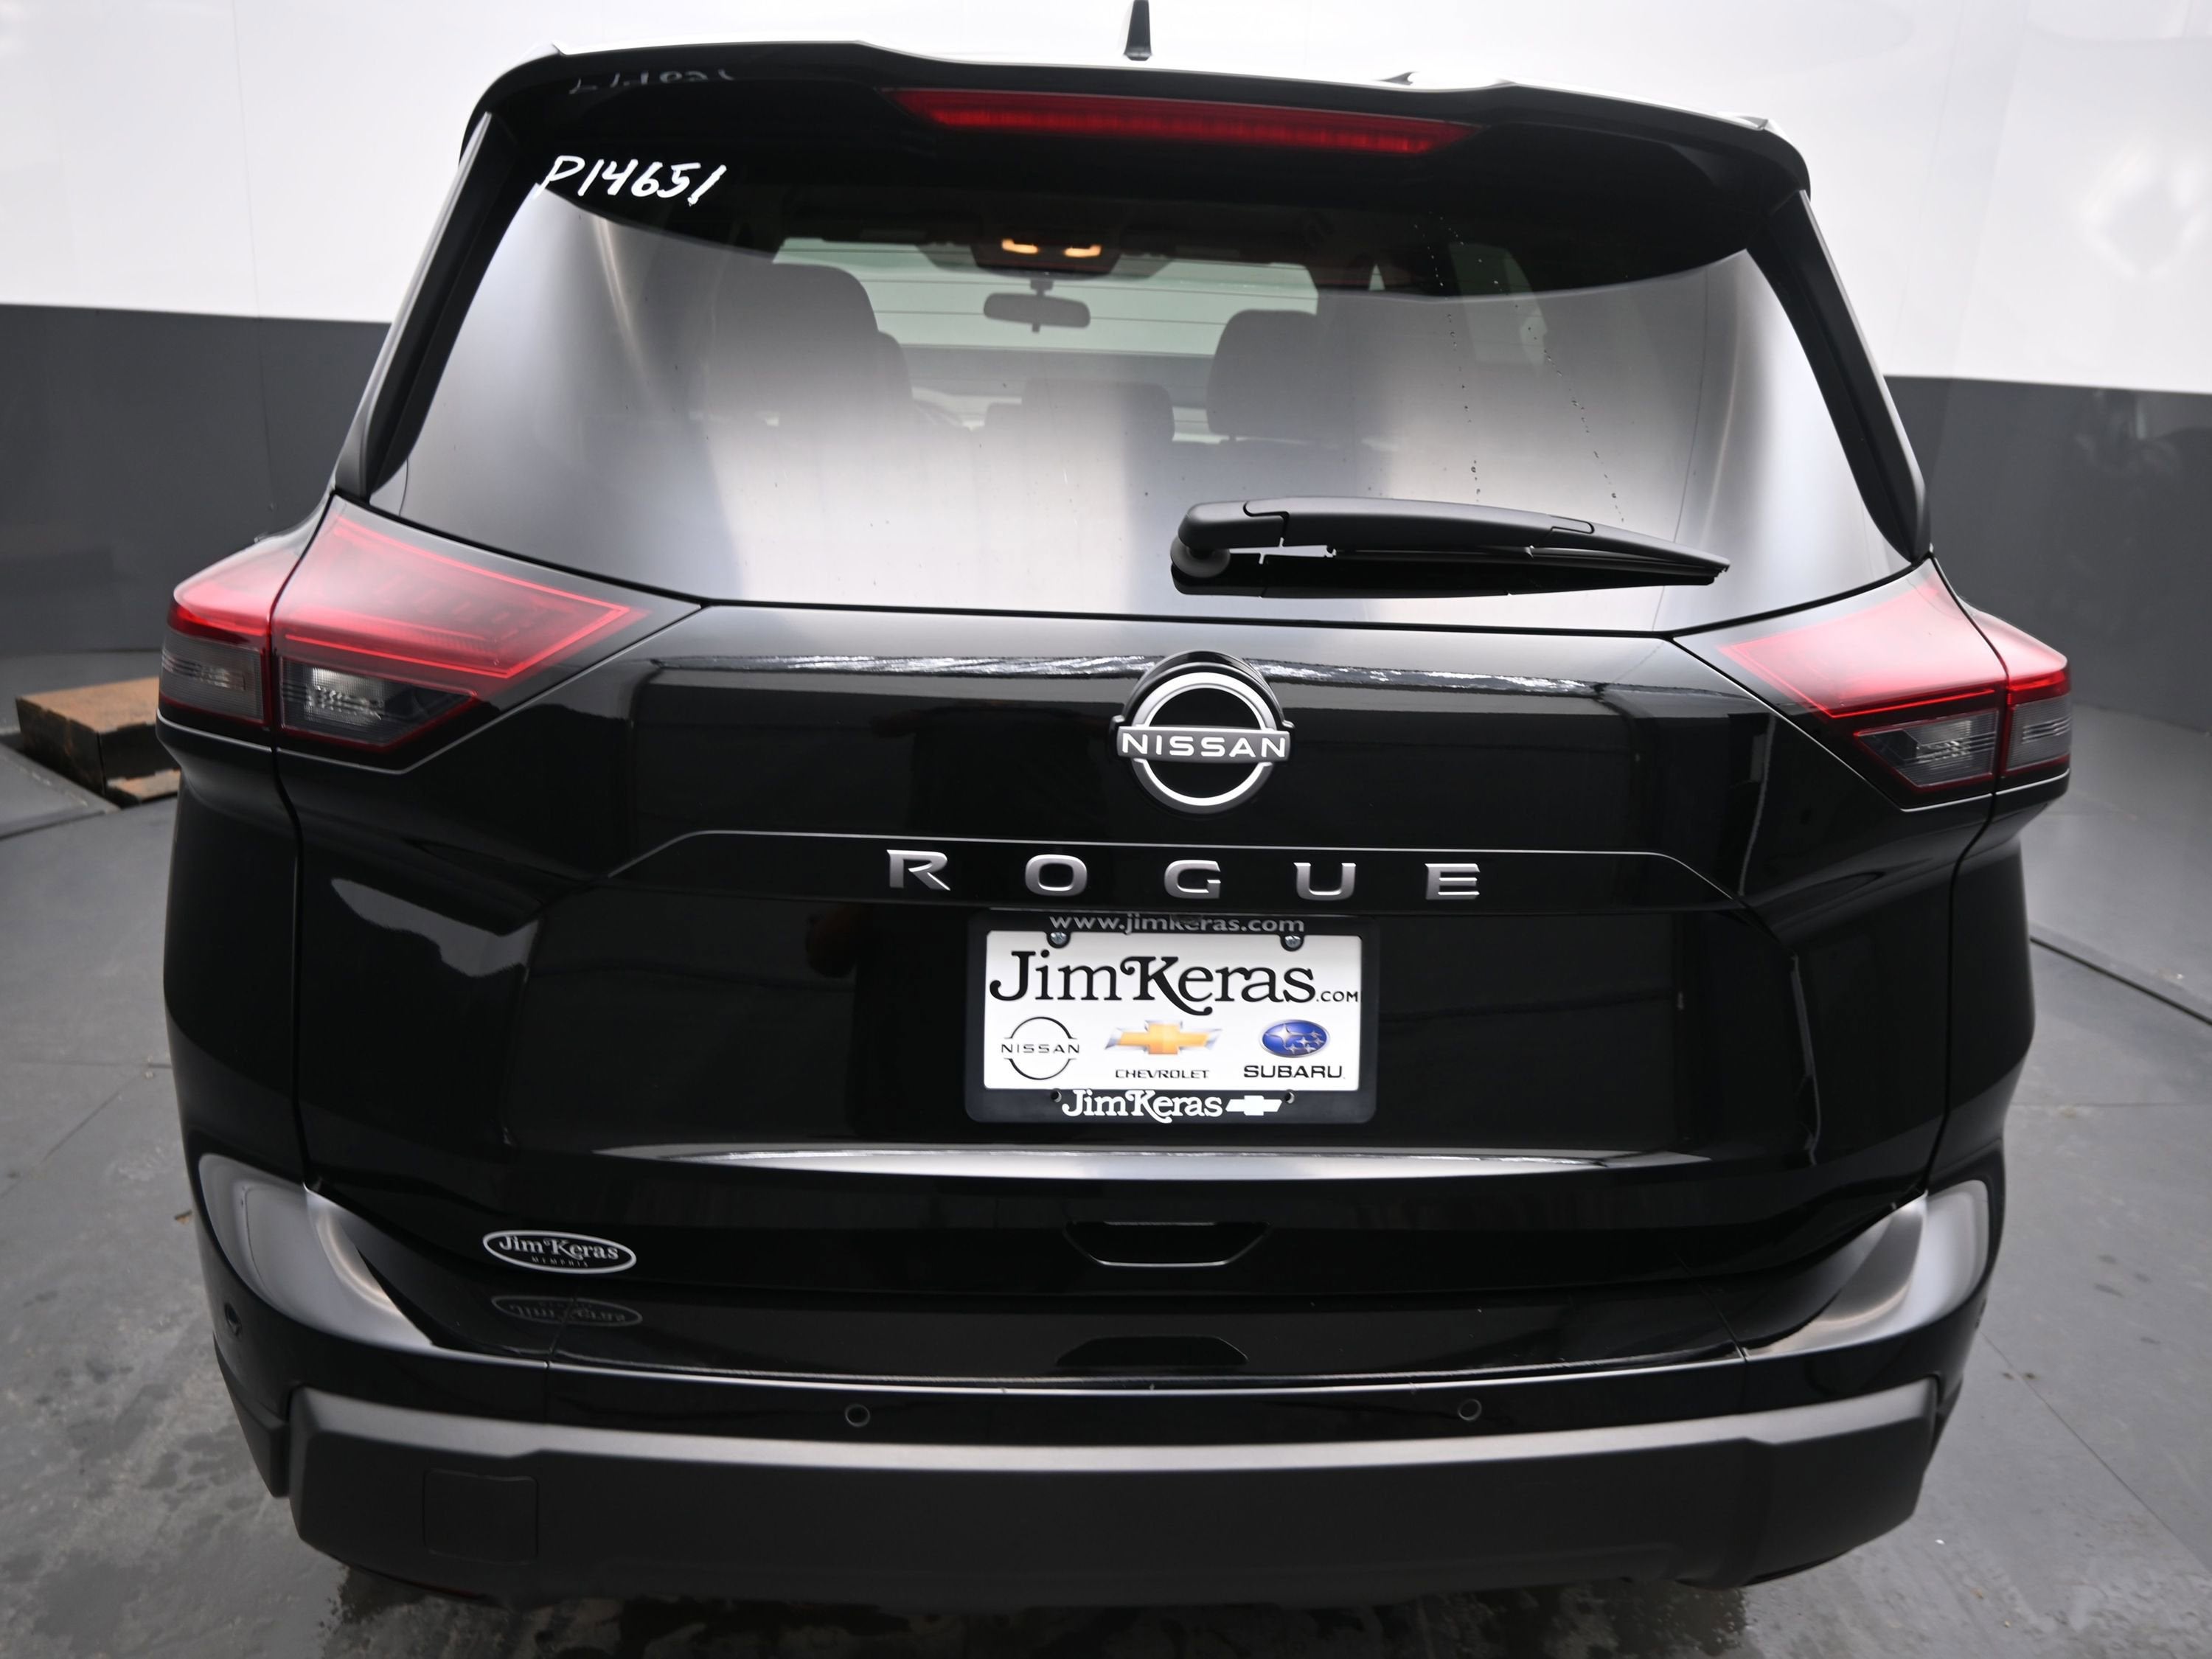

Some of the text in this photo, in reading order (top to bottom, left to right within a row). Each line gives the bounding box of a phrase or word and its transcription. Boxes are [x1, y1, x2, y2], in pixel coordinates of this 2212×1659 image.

[1121, 732, 1286, 758] NISSAN
[886, 849, 1481, 900] ROGUE
[1049, 913, 1304, 934] www.jimkeras.com
[1001, 1043, 1080, 1054] NISSAN
[1115, 1068, 1210, 1079] CHEVROLET
[1243, 1065, 1343, 1079] SUBARU
